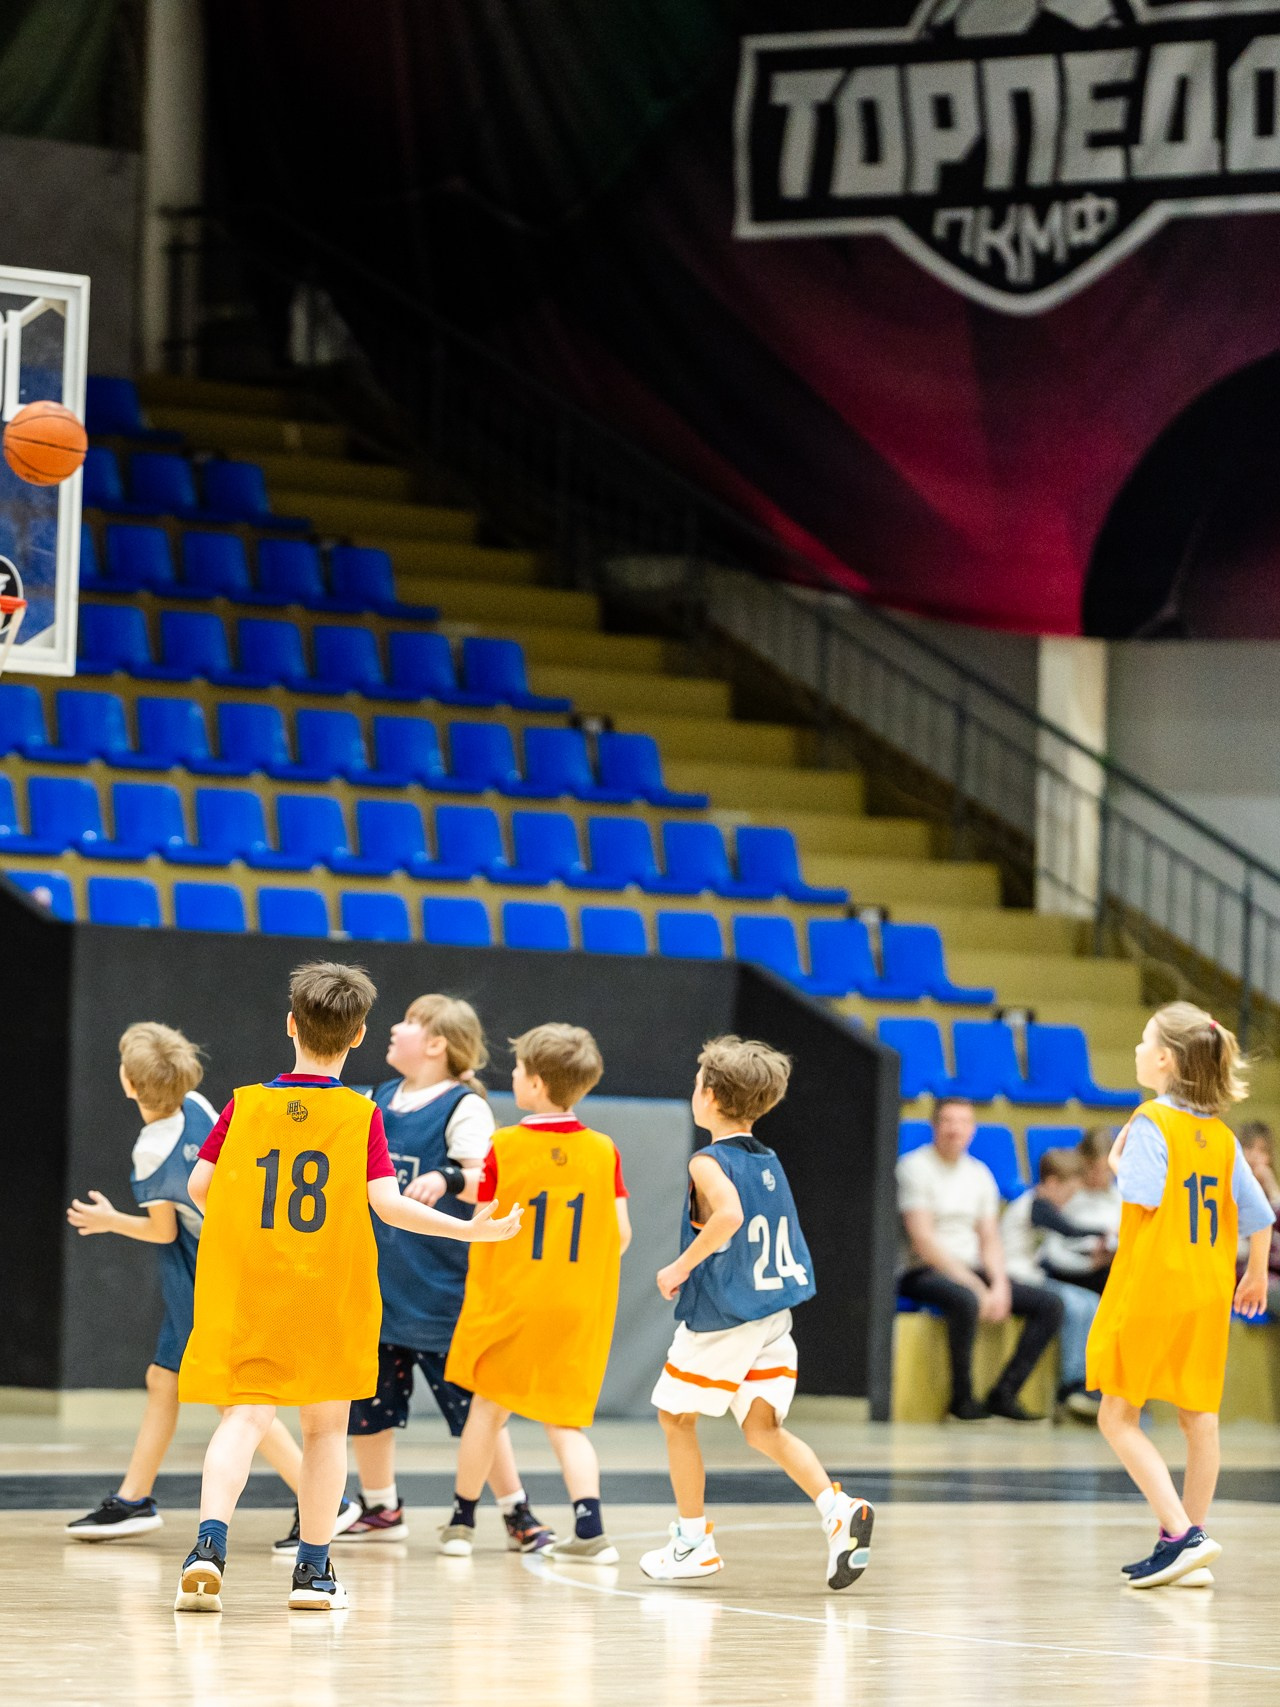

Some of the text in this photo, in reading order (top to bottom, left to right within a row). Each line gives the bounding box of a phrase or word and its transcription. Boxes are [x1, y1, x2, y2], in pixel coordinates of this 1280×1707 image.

[770, 34, 1280, 198] ТОРПЕДО
[932, 193, 1117, 285] ПКМФ
[256, 1149, 330, 1233] 18
[528, 1190, 585, 1262] 11
[1183, 1171, 1218, 1247] 15
[747, 1213, 809, 1291] 24
